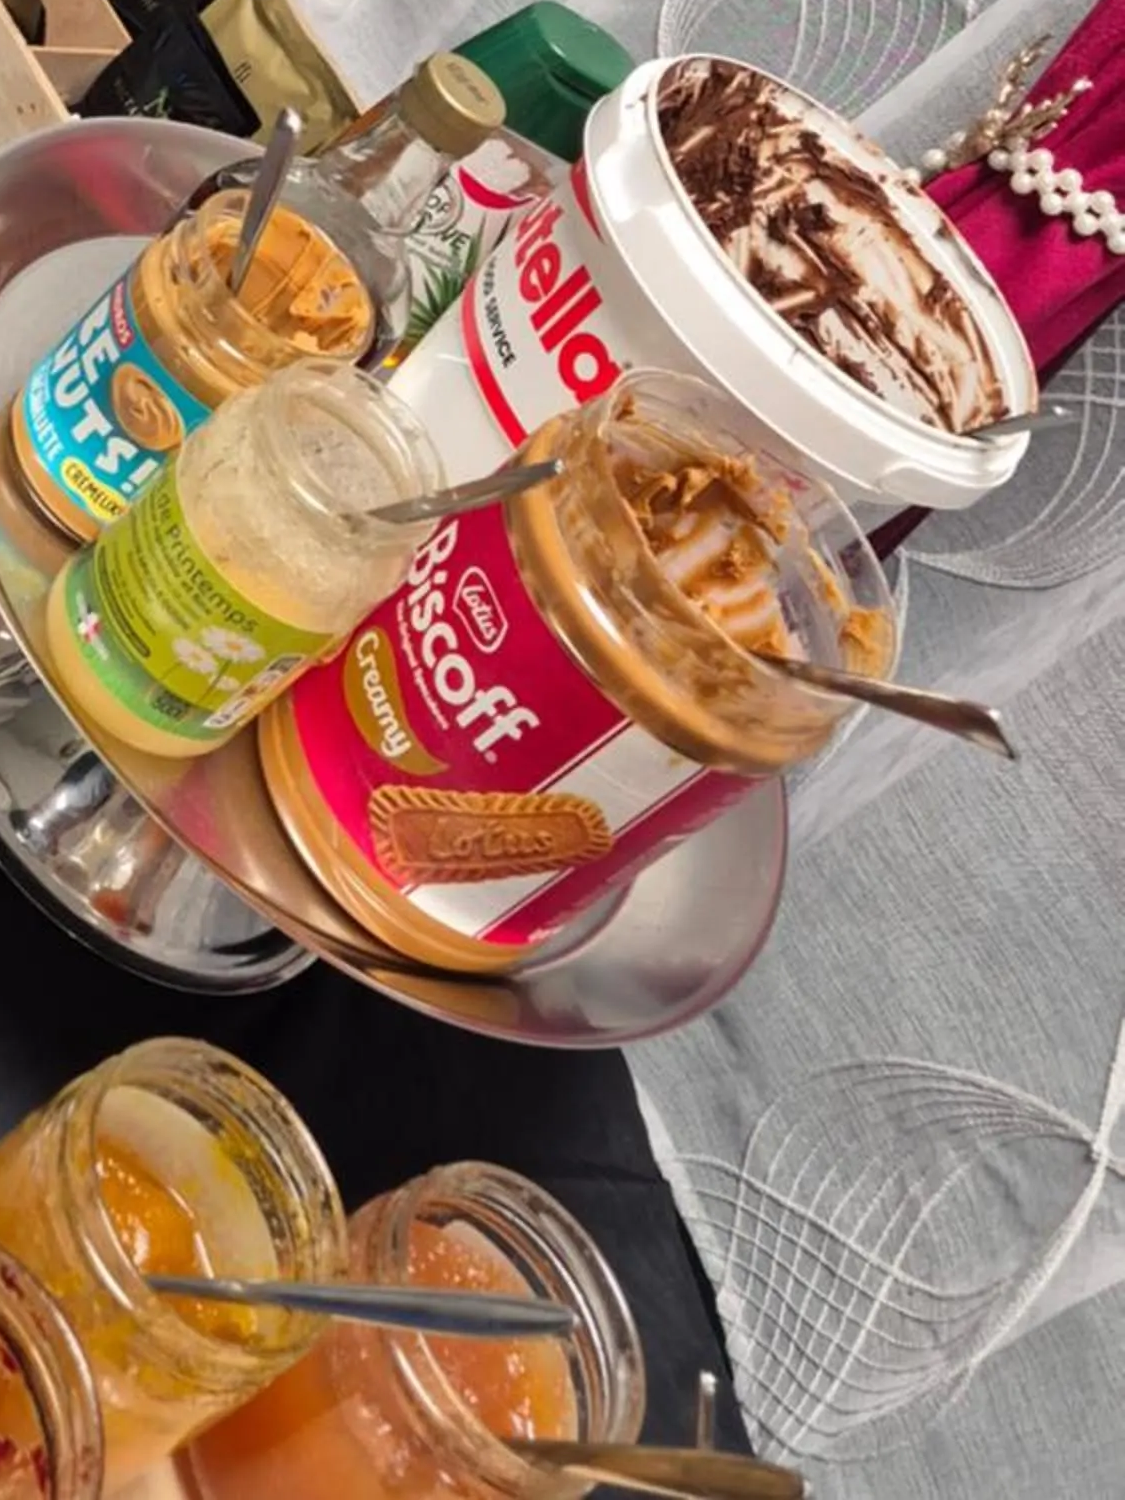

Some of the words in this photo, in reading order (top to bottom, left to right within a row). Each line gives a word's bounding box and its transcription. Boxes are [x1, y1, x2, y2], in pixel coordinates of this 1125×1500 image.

[483, 296, 517, 369] SERVICE
[516, 197, 623, 406] utella
[51, 334, 160, 494] NUTS!
[165, 526, 260, 634] Printemps
[407, 520, 540, 753] Biscoff
[356, 631, 412, 757] Creamy
